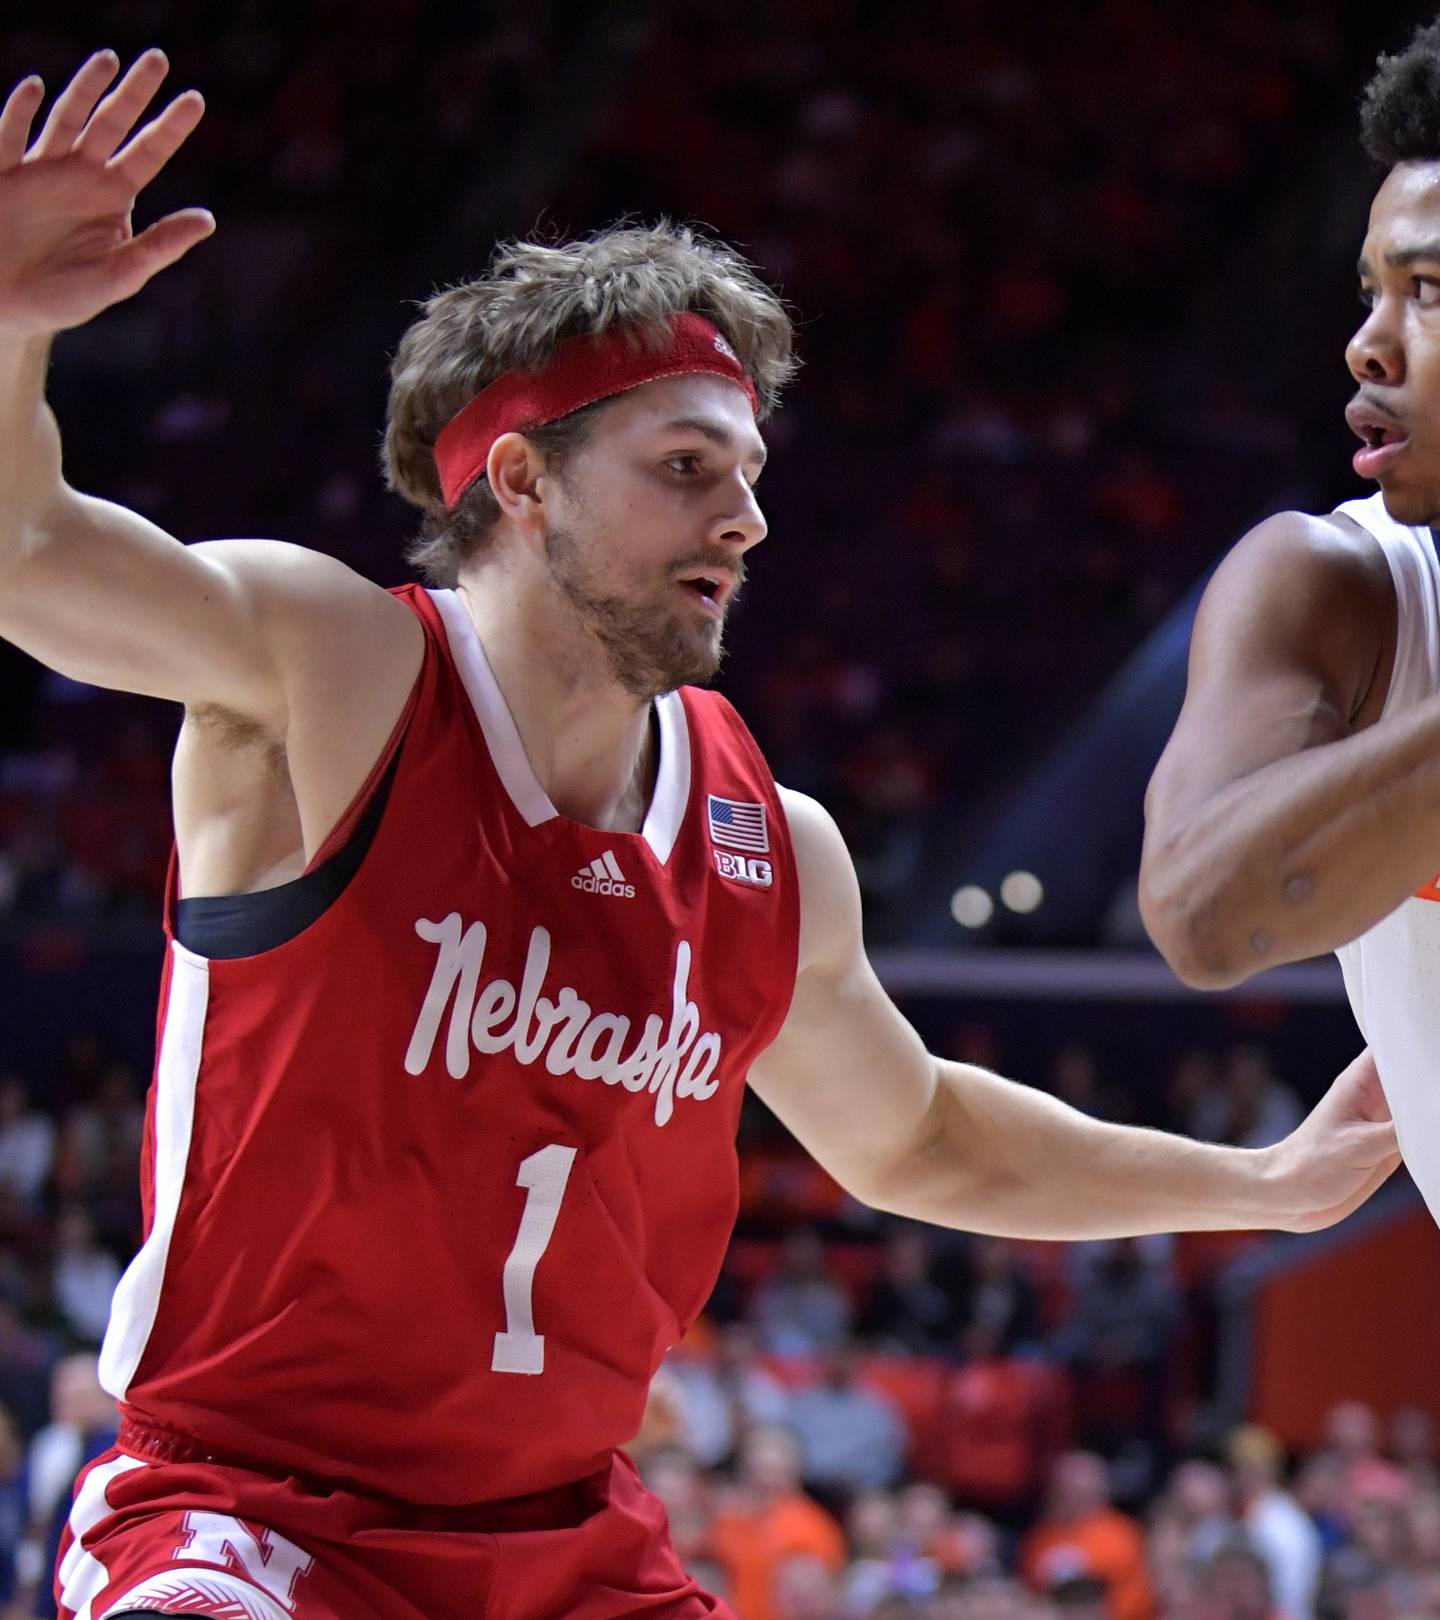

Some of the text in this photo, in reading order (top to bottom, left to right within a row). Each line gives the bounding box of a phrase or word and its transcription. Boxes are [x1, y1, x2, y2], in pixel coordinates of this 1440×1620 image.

[571, 874, 636, 899] adidas
[404, 911, 721, 1127] Nebraska
[491, 1143, 578, 1374] 1
[172, 1510, 315, 1614] N
